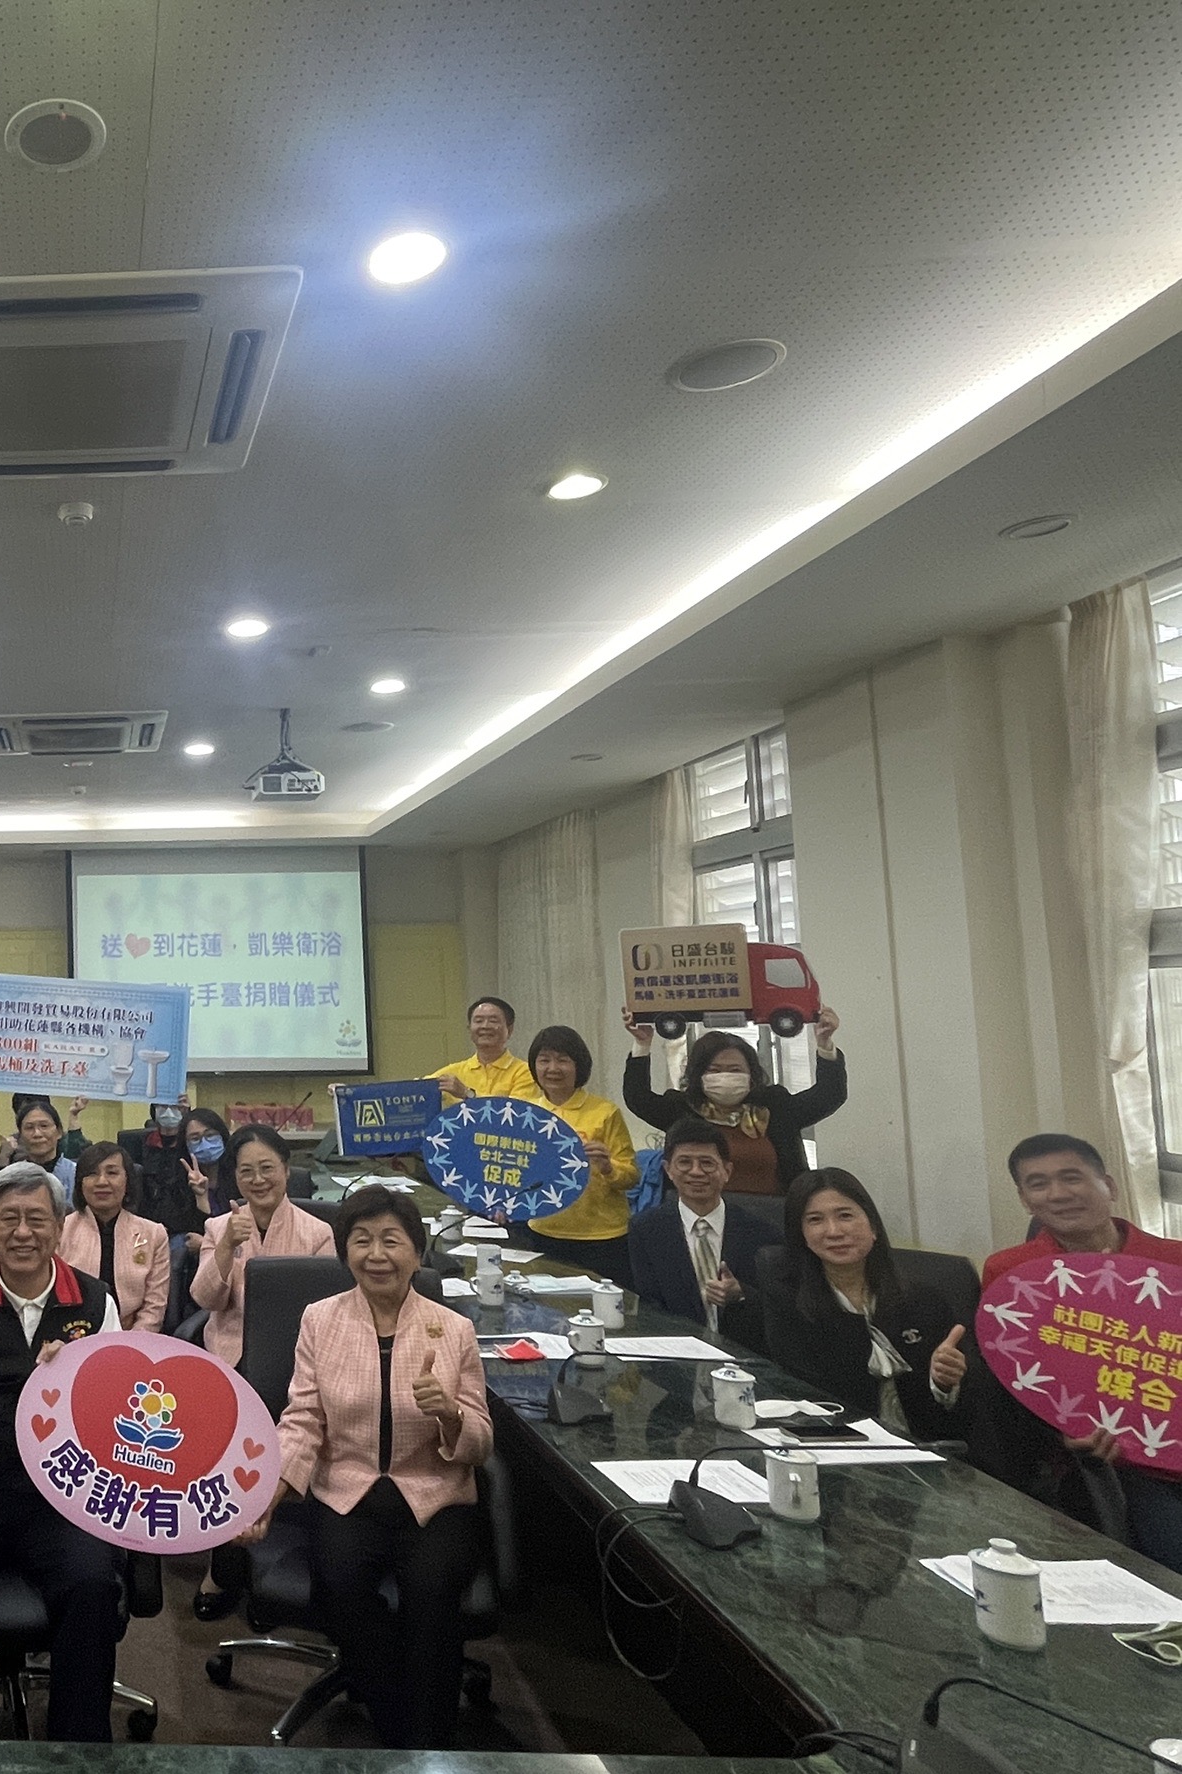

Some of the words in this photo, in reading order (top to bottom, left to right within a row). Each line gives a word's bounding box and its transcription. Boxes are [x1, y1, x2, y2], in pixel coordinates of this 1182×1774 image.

[385, 1094, 426, 1106] ZONTA
[479, 1147, 530, 1169] 台北二社
[483, 1164, 522, 1188] 促成
[1096, 1364, 1177, 1412] 媒合
[114, 1444, 175, 1474] Hualien
[41, 1438, 240, 1538] 感謝有您
